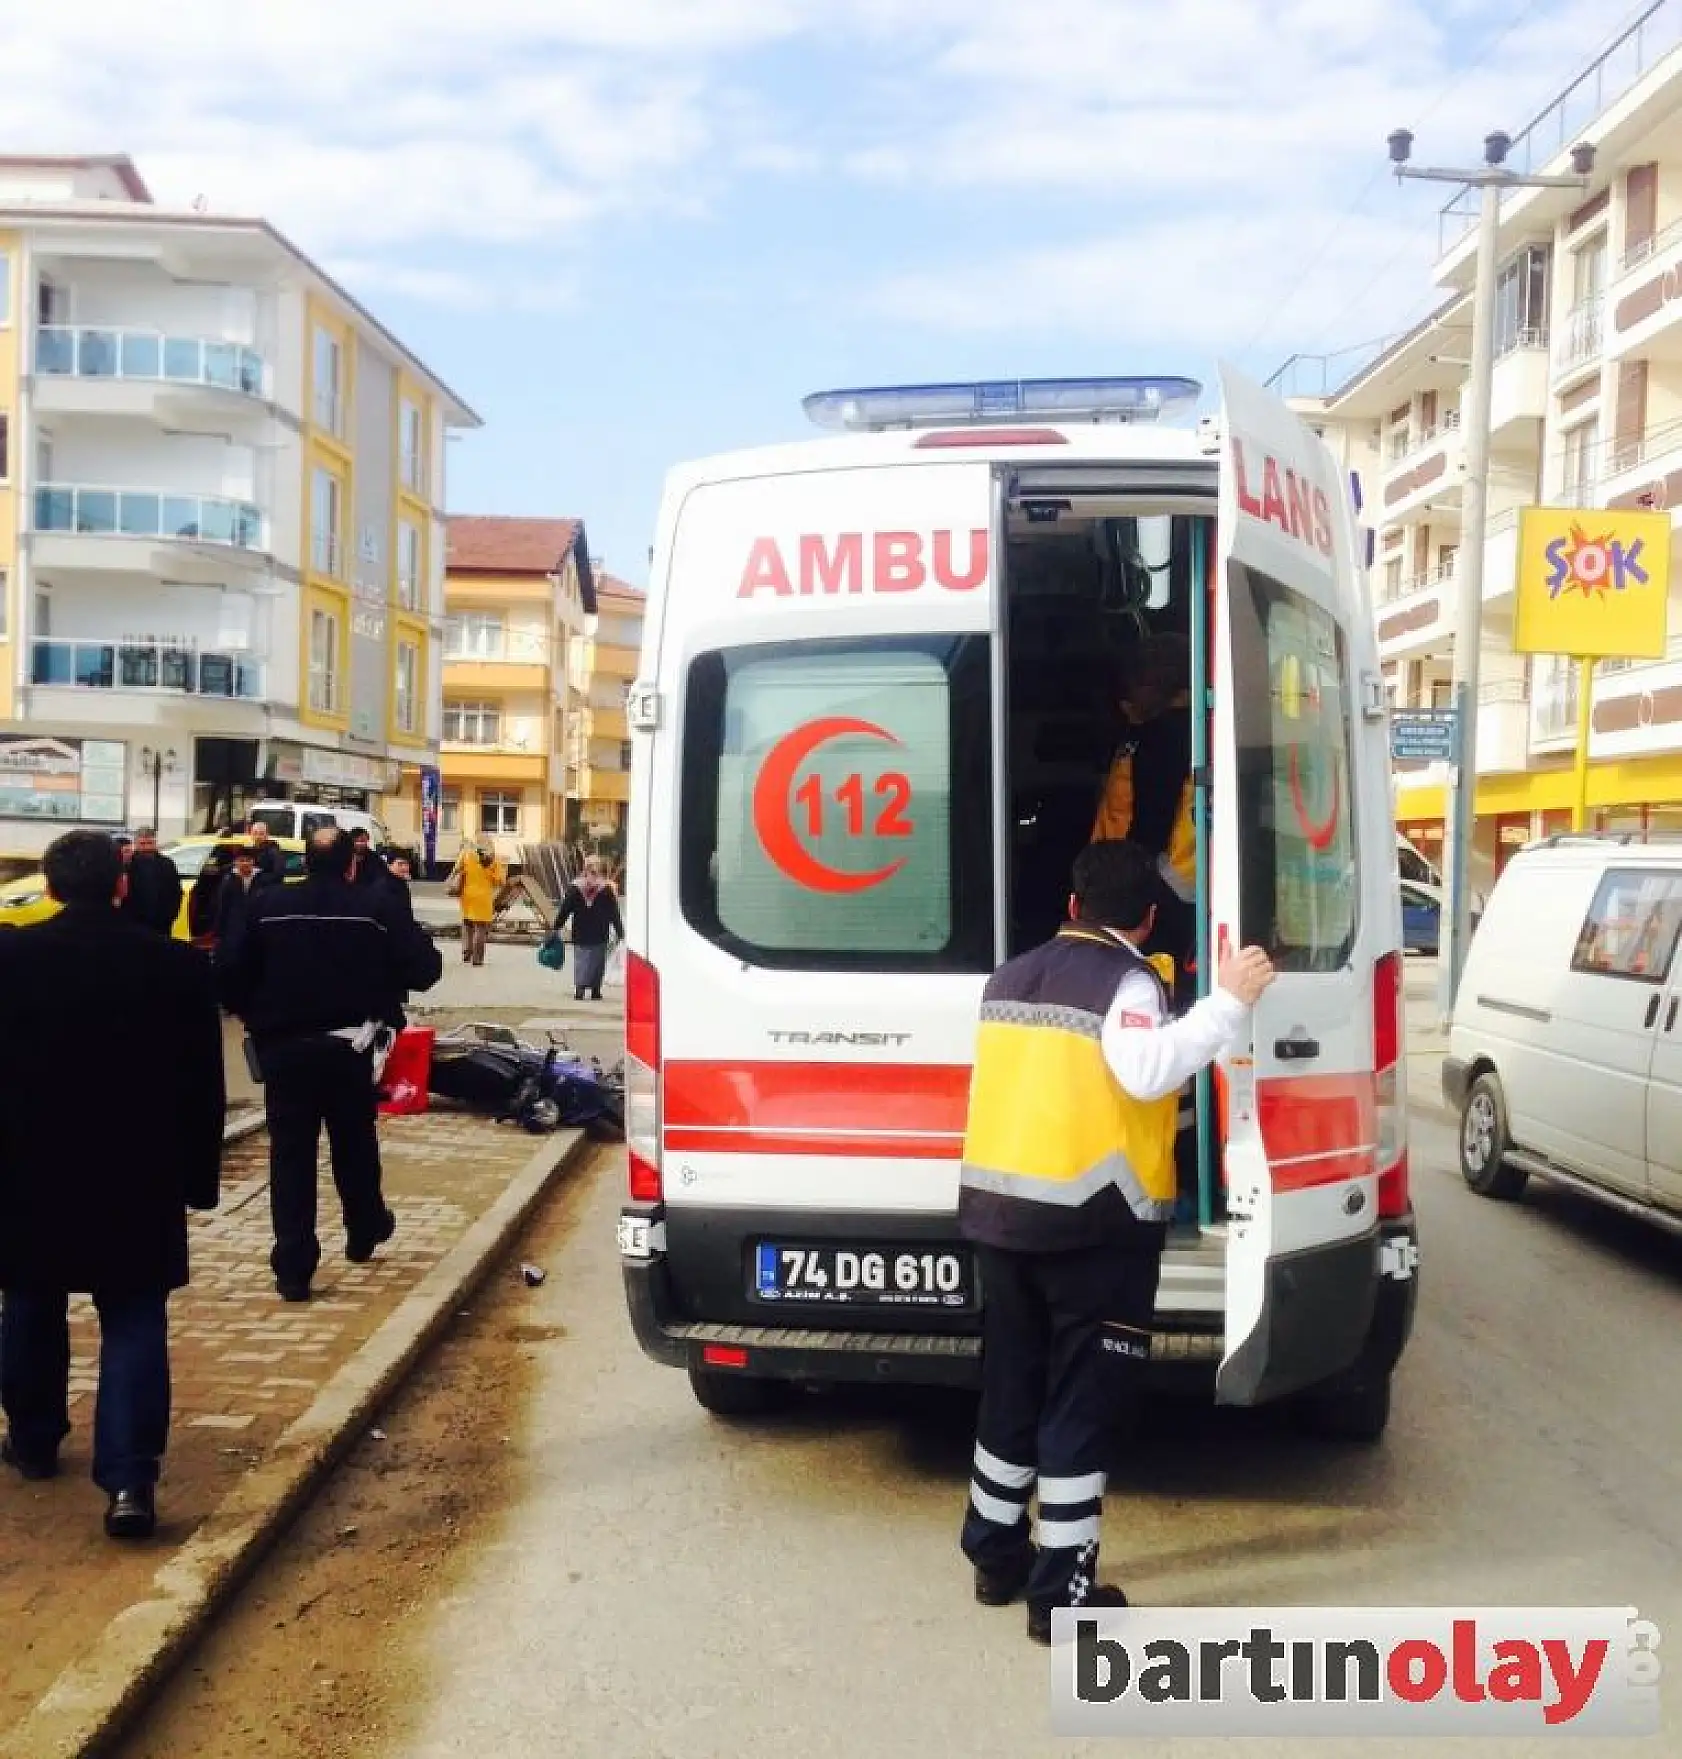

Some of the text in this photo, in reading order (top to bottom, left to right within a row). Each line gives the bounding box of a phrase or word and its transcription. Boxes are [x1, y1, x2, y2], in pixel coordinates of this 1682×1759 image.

[1231, 436, 1336, 558] LANS
[736, 528, 989, 598] AMBU
[1546, 536, 1649, 600] ŞOK
[796, 773, 913, 836] 112
[767, 1030, 913, 1046] TRANSIT
[782, 1250, 960, 1291] 74 DG 610
